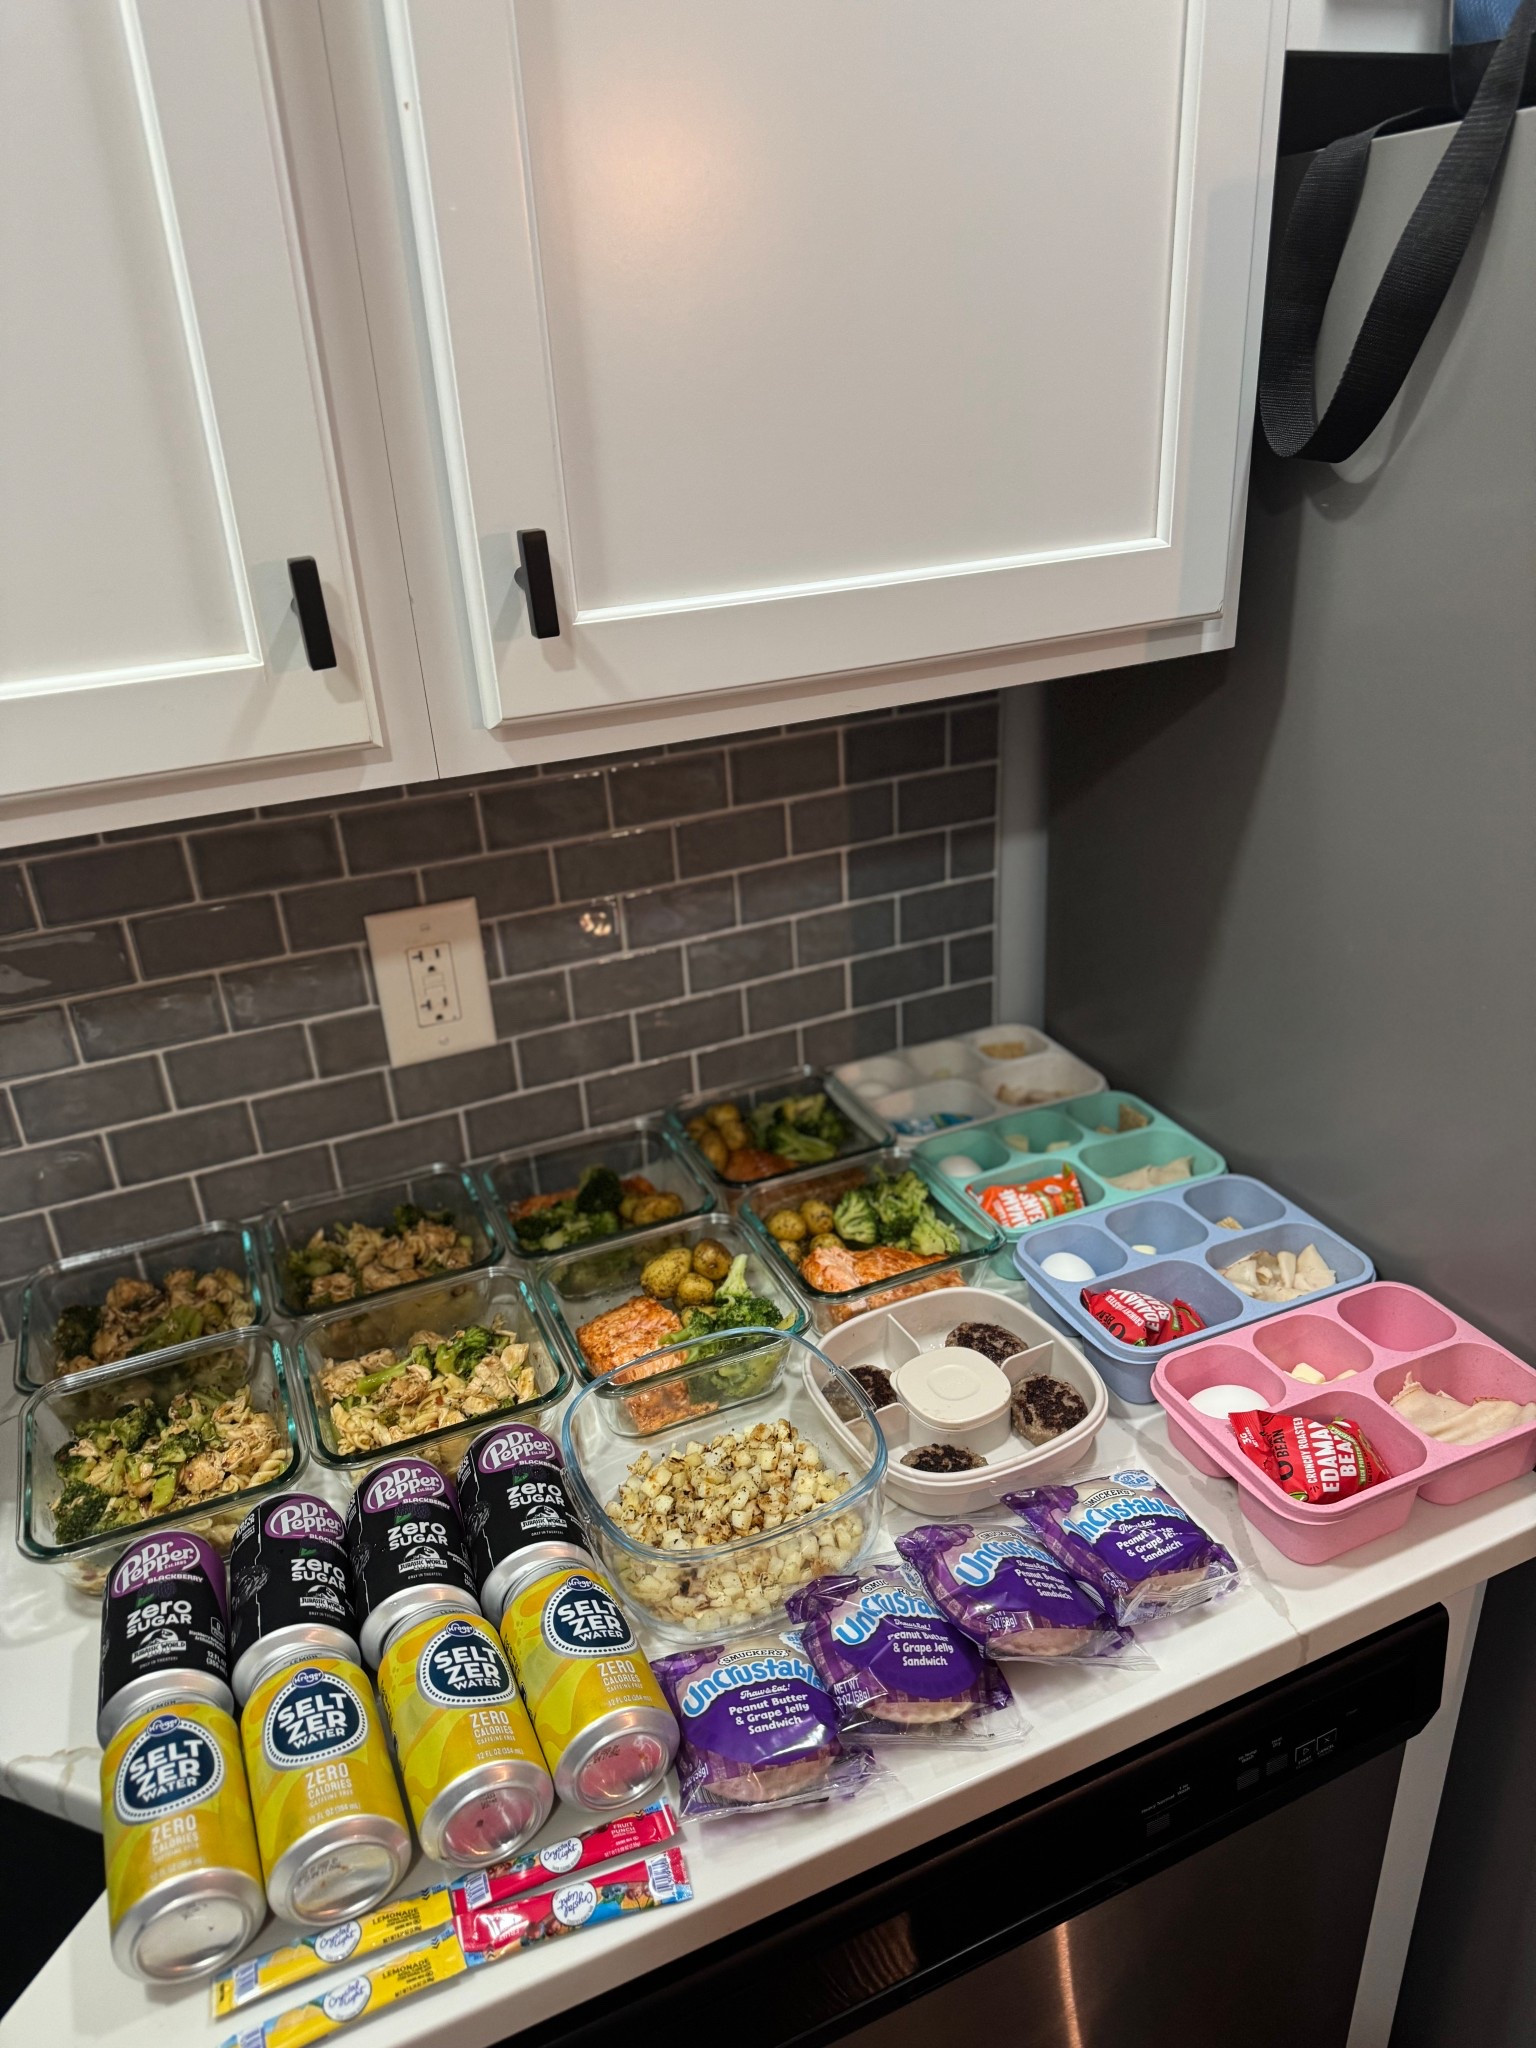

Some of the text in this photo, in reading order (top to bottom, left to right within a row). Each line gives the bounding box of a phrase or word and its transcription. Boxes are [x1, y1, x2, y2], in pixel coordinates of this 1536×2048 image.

[506, 1431, 534, 1446] Dr
[1272, 1428, 1290, 1458] BEAN
[482, 1438, 551, 1470] Pepper
[393, 1468, 422, 1486] Dr
[1300, 1451, 1318, 1484] CRUNCHY
[367, 1476, 440, 1510] Pepper
[506, 1482, 562, 1501] zero
[509, 1494, 566, 1510] SUGAR
[270, 1506, 342, 1536] Pepper
[300, 1502, 328, 1518] Dr
[388, 1520, 447, 1542] zero
[1116, 1531, 1148, 1550] Peanut
[141, 1541, 174, 1561] Dr
[389, 1534, 448, 1551] SUGAR
[1126, 1536, 1164, 1557] & Grape
[1141, 1540, 1184, 1562] Sandwich
[114, 1548, 194, 1594] Pepper
[291, 1558, 345, 1582] zero
[291, 1571, 346, 1594] SUGAR
[127, 1600, 192, 1629] zero
[557, 1600, 616, 1622] SELT
[126, 1613, 192, 1639] SUGAR
[568, 1614, 624, 1636] ZER
[578, 1630, 624, 1642] WATER
[433, 1645, 496, 1670] SELT
[722, 1650, 784, 1665] SMUCKER'S
[893, 1642, 954, 1655] & Grape Jelly
[597, 1660, 636, 1677] ZERO
[902, 1656, 948, 1667] Sandwich
[294, 1672, 322, 1684] Kroger
[444, 1662, 502, 1686] ZER
[454, 1678, 501, 1691] WATER
[602, 1674, 640, 1686] CALORIES
[277, 1692, 347, 1729] SELT
[728, 1693, 808, 1716] Peanut Butter
[735, 1702, 810, 1726] & Grape Jelly
[149, 1716, 178, 1734] Kroger
[285, 1710, 348, 1745] ZER
[469, 1710, 510, 1729] ZERO
[748, 1716, 802, 1735] Sandwich
[292, 1726, 346, 1750] WATER
[474, 1726, 514, 1738] CALORIES
[129, 1740, 204, 1782] SELT
[136, 1758, 200, 1798] ZER
[305, 1762, 349, 1790] ZERO
[142, 1776, 198, 1804] WATER
[308, 1778, 352, 1800] CALORIES
[151, 1814, 197, 1844] ZERO
[611, 1826, 636, 1836] PUNCH
[152, 1831, 199, 1856] CALORIES
[544, 1840, 572, 1862] Crystal
[558, 1843, 578, 1860] Light
[558, 1891, 578, 1910] Light
[564, 1891, 593, 1918] Crystal
[372, 1908, 420, 1925] LEMONADE
[382, 1958, 430, 1980] LEMONADE
